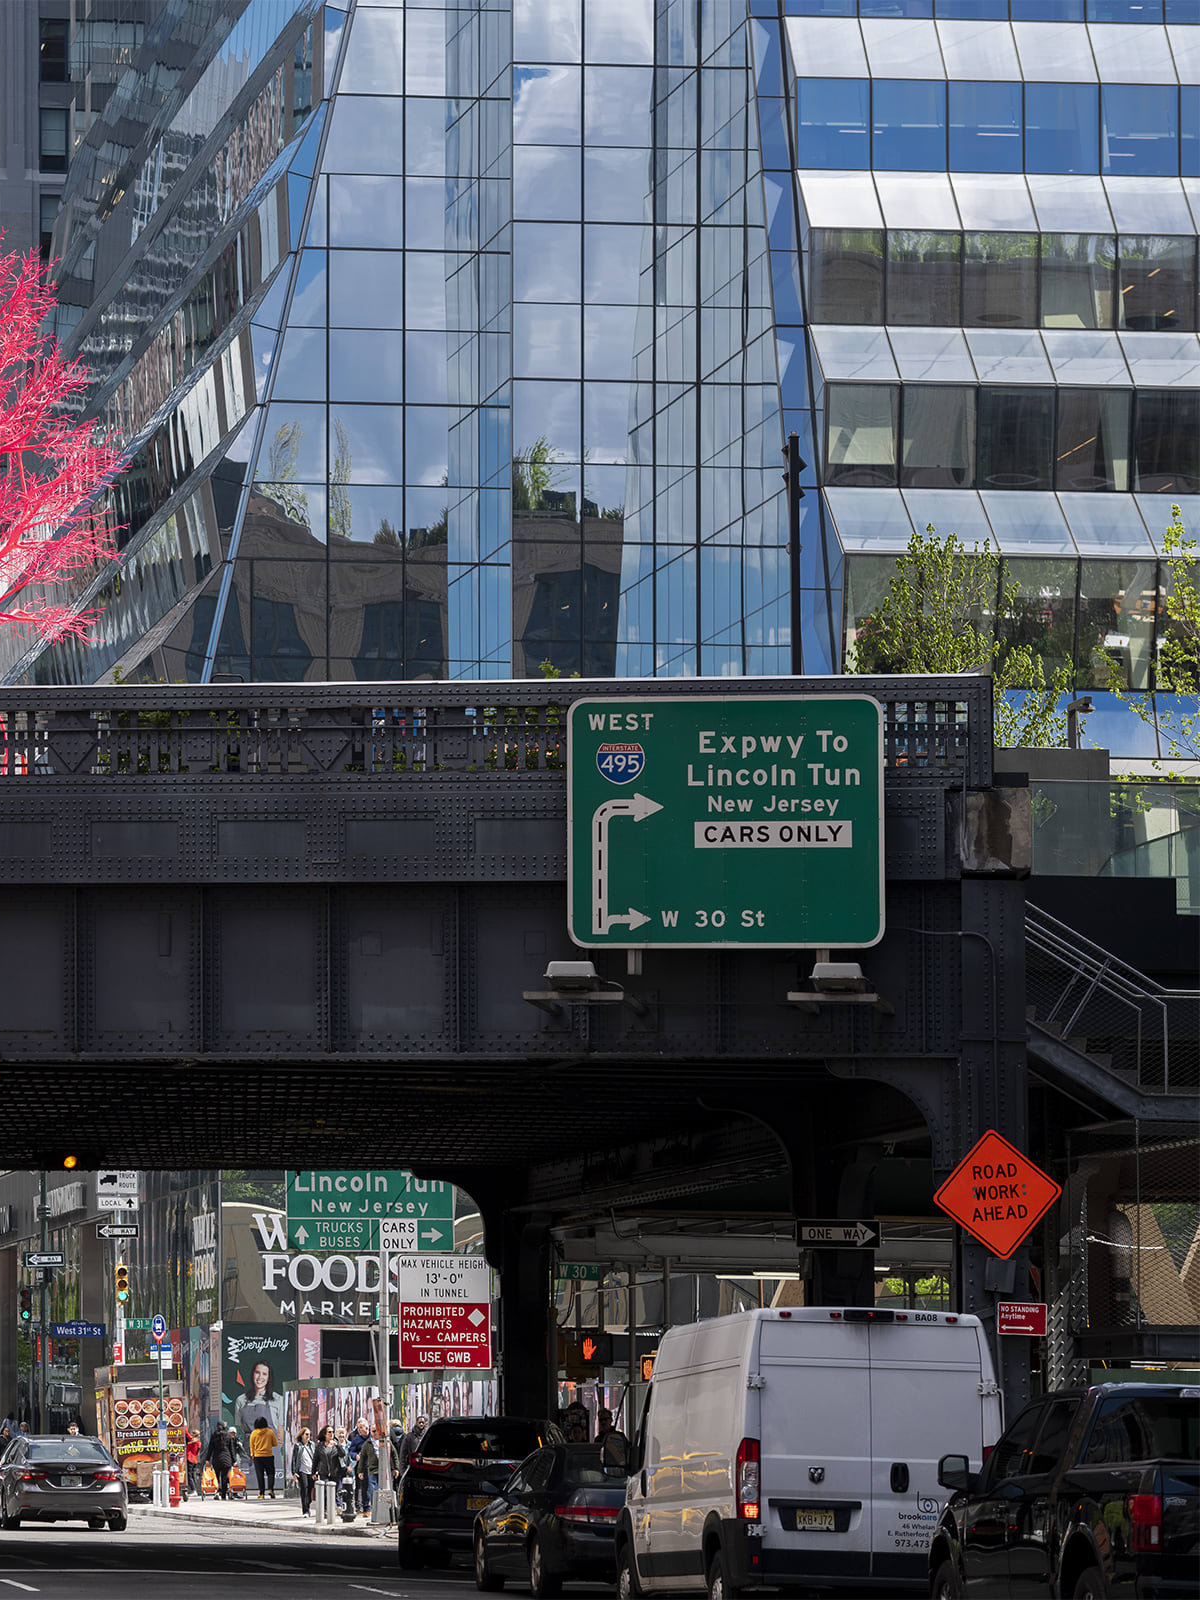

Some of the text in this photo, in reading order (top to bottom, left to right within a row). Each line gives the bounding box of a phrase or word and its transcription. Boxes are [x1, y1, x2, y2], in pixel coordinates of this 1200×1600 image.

[588, 713, 654, 731] WEST
[699, 730, 849, 759] Expwy To
[600, 754, 640, 773] 495
[687, 763, 861, 787] Lincoln Tun
[707, 795, 839, 816] New Jersey
[704, 825, 843, 843] CARS ONLY
[661, 910, 765, 928] W 30 St
[972, 1163, 1018, 1180] ROAD
[294, 1171, 445, 1193] Lincoln Tun
[974, 1184, 1020, 1201] WORK
[311, 1199, 429, 1217] New Jersey
[972, 1204, 1028, 1222] AHEAD
[315, 1222, 363, 1233] TRUCKS
[382, 1222, 415, 1233] CARS
[808, 1228, 869, 1241] ONE WAY
[319, 1236, 361, 1248] BUSES
[382, 1238, 415, 1249] ONLY
[401, 1259, 417, 1268] MAX
[421, 1259, 454, 1269] VEHICLE
[559, 1264, 568, 1278] W
[572, 1265, 587, 1279] 30
[420, 1288, 469, 1298] IN TUNNEL
[280, 1300, 372, 1316] MARKE
[402, 1306, 465, 1316] PROHIBITED
[914, 1313, 938, 1322] BA08
[1000, 1312, 1026, 1320] Anytime
[128, 1320, 135, 1328] W
[136, 1319, 143, 1328] 31
[402, 1319, 452, 1329] HAZMATS
[56, 1326, 101, 1335] West 31st St
[402, 1332, 420, 1342] RVs
[437, 1332, 487, 1343] CAMPERS
[238, 1336, 289, 1353] Everything
[419, 1351, 471, 1363] USE GWB
[898, 1512, 937, 1521] brookaire
